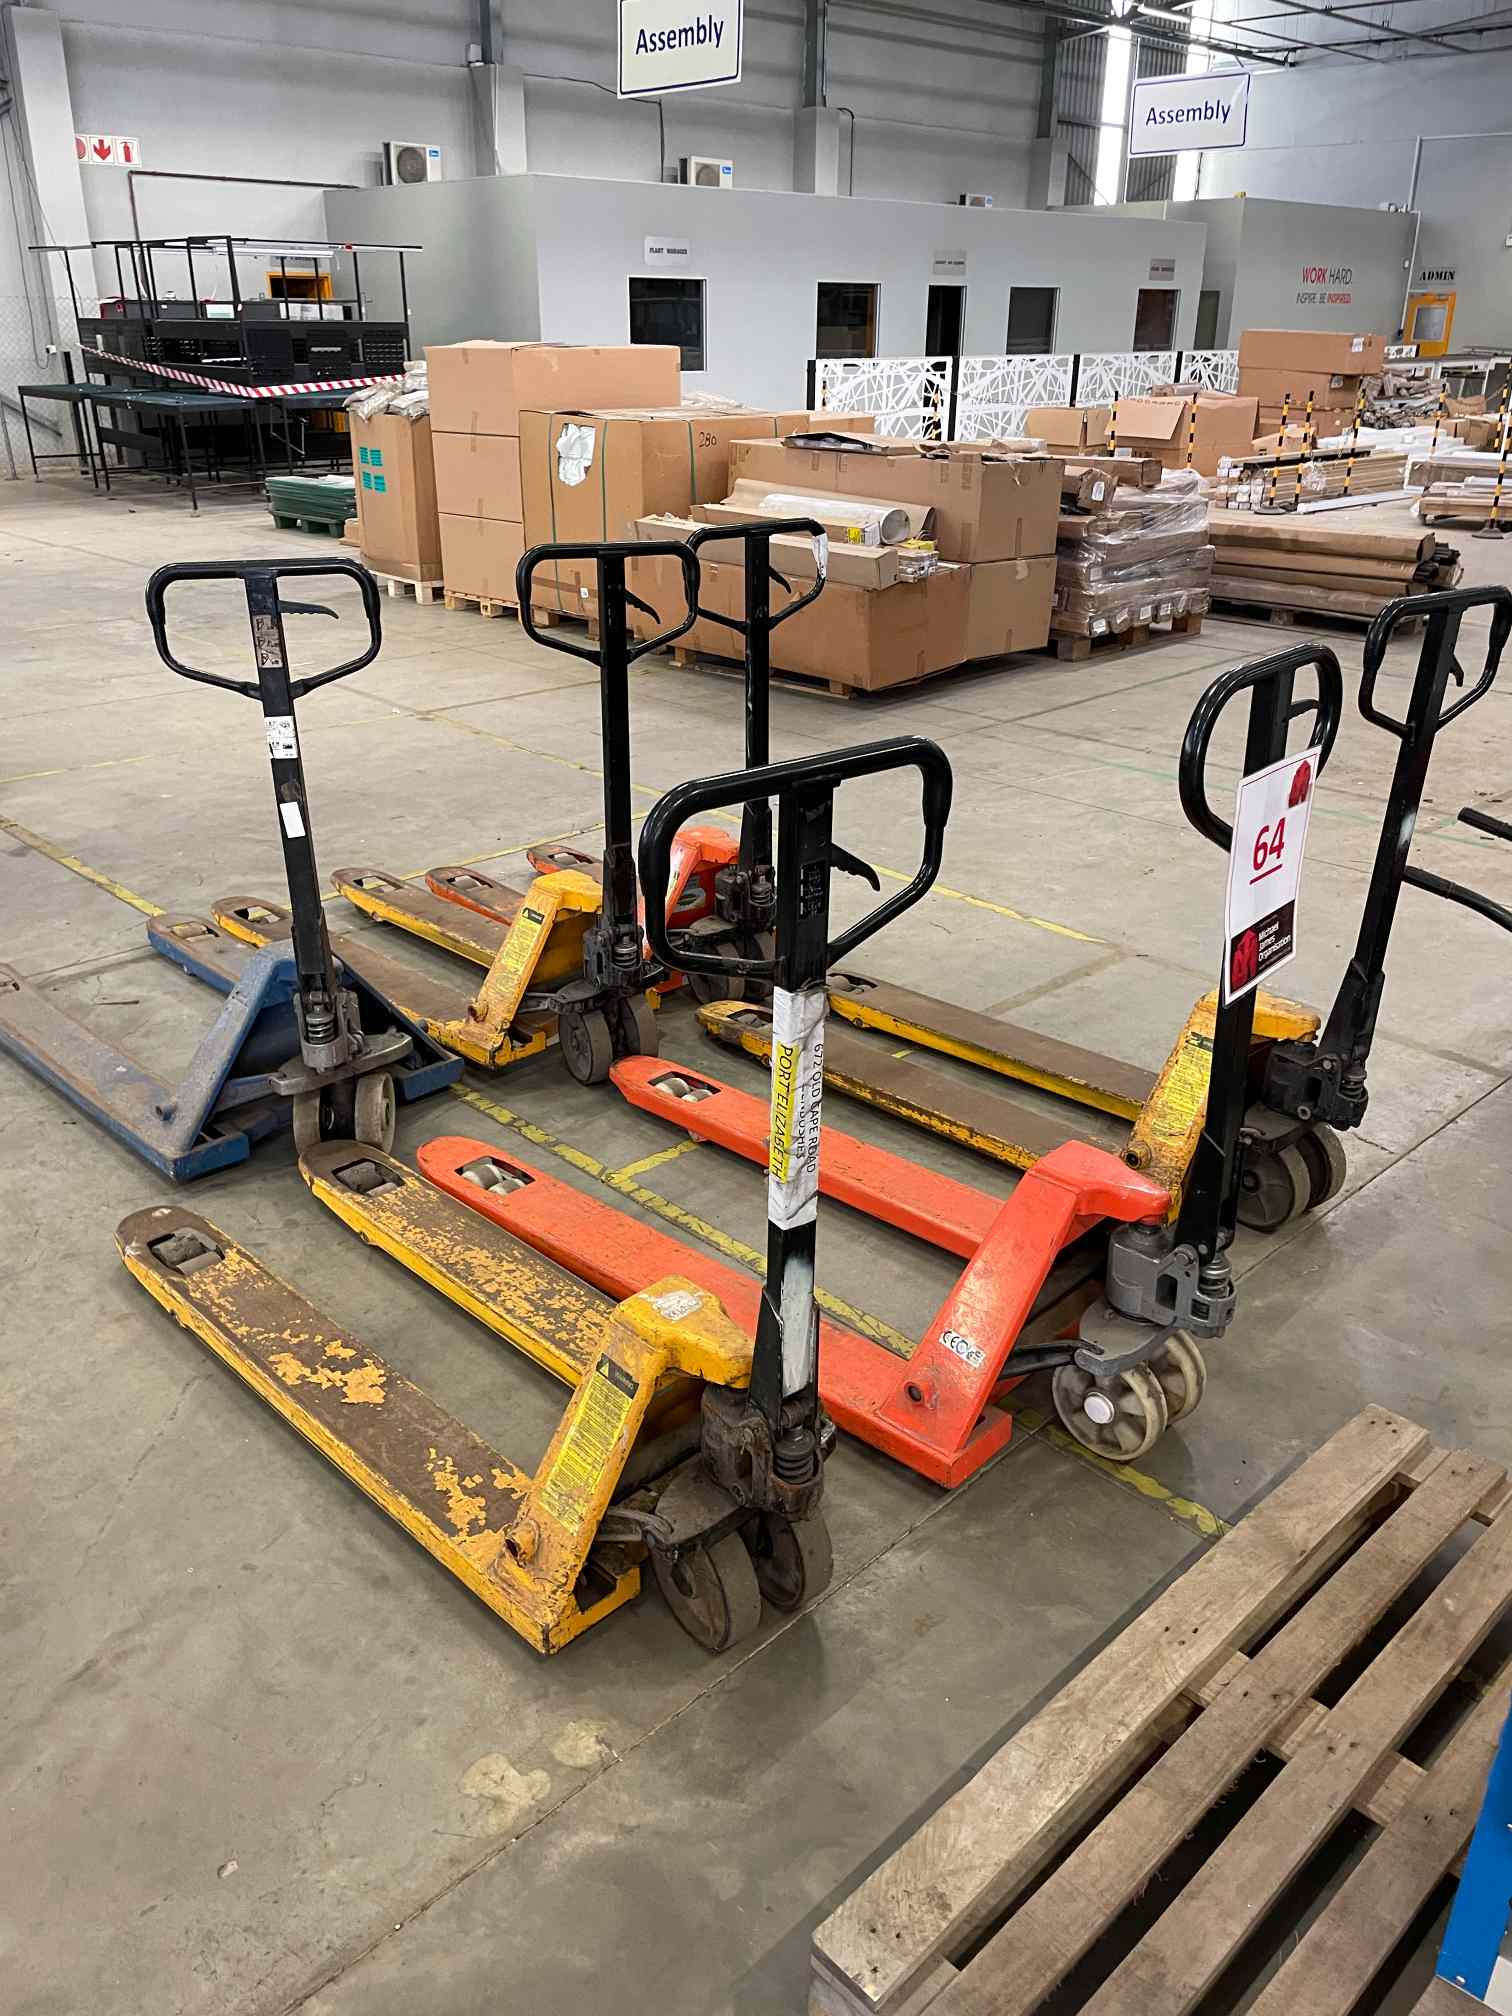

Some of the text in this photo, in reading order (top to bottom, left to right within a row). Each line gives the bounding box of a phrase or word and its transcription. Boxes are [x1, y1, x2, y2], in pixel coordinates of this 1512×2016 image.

[636, 15, 724, 55] Assembly
[1146, 100, 1231, 126] Assembly
[1302, 266, 1328, 284] WORK
[1419, 271, 1456, 281] ADMIN
[699, 431, 717, 448] 280
[1253, 817, 1286, 872] 64
[1258, 921, 1279, 942] Michael
[1258, 935, 1276, 952] James
[1258, 935, 1291, 962] Organisation
[772, 1044, 793, 1180] PORT ELIZABETH
[807, 1043, 823, 1173] 672 OLD CAPE ROAD
